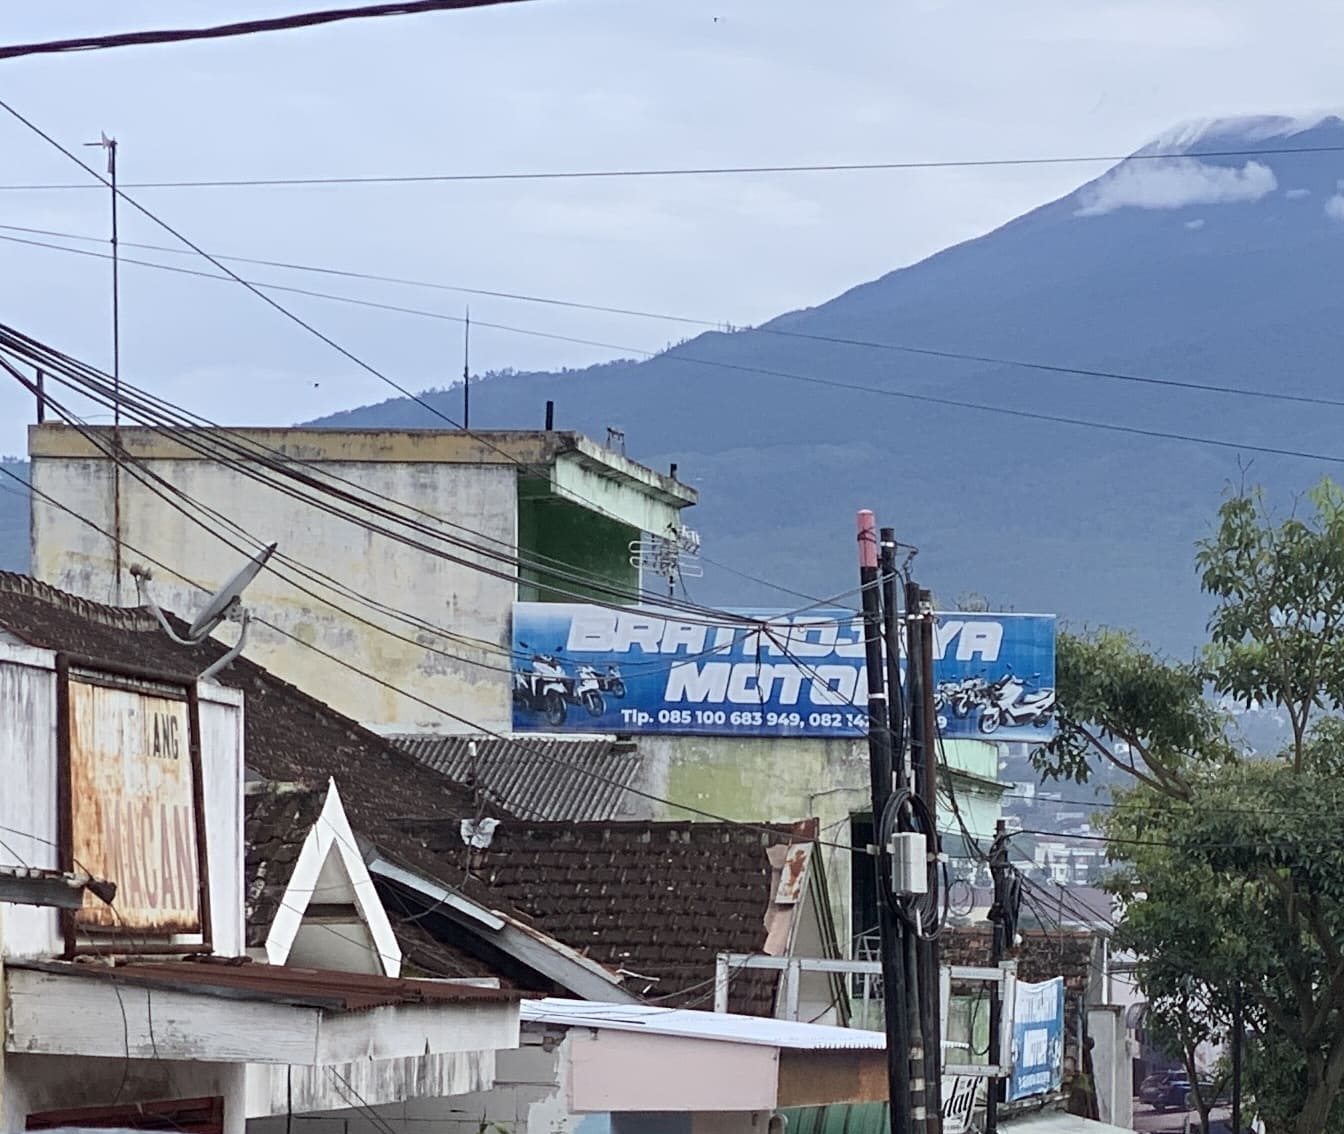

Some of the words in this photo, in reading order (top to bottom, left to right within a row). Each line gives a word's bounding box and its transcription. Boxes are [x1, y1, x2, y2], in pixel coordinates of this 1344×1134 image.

[658, 709, 692, 726] 085
[695, 710, 727, 727] 100
[730, 711, 764, 727] 683
[767, 712, 805, 729] 949,
[808, 713, 843, 728] 082
